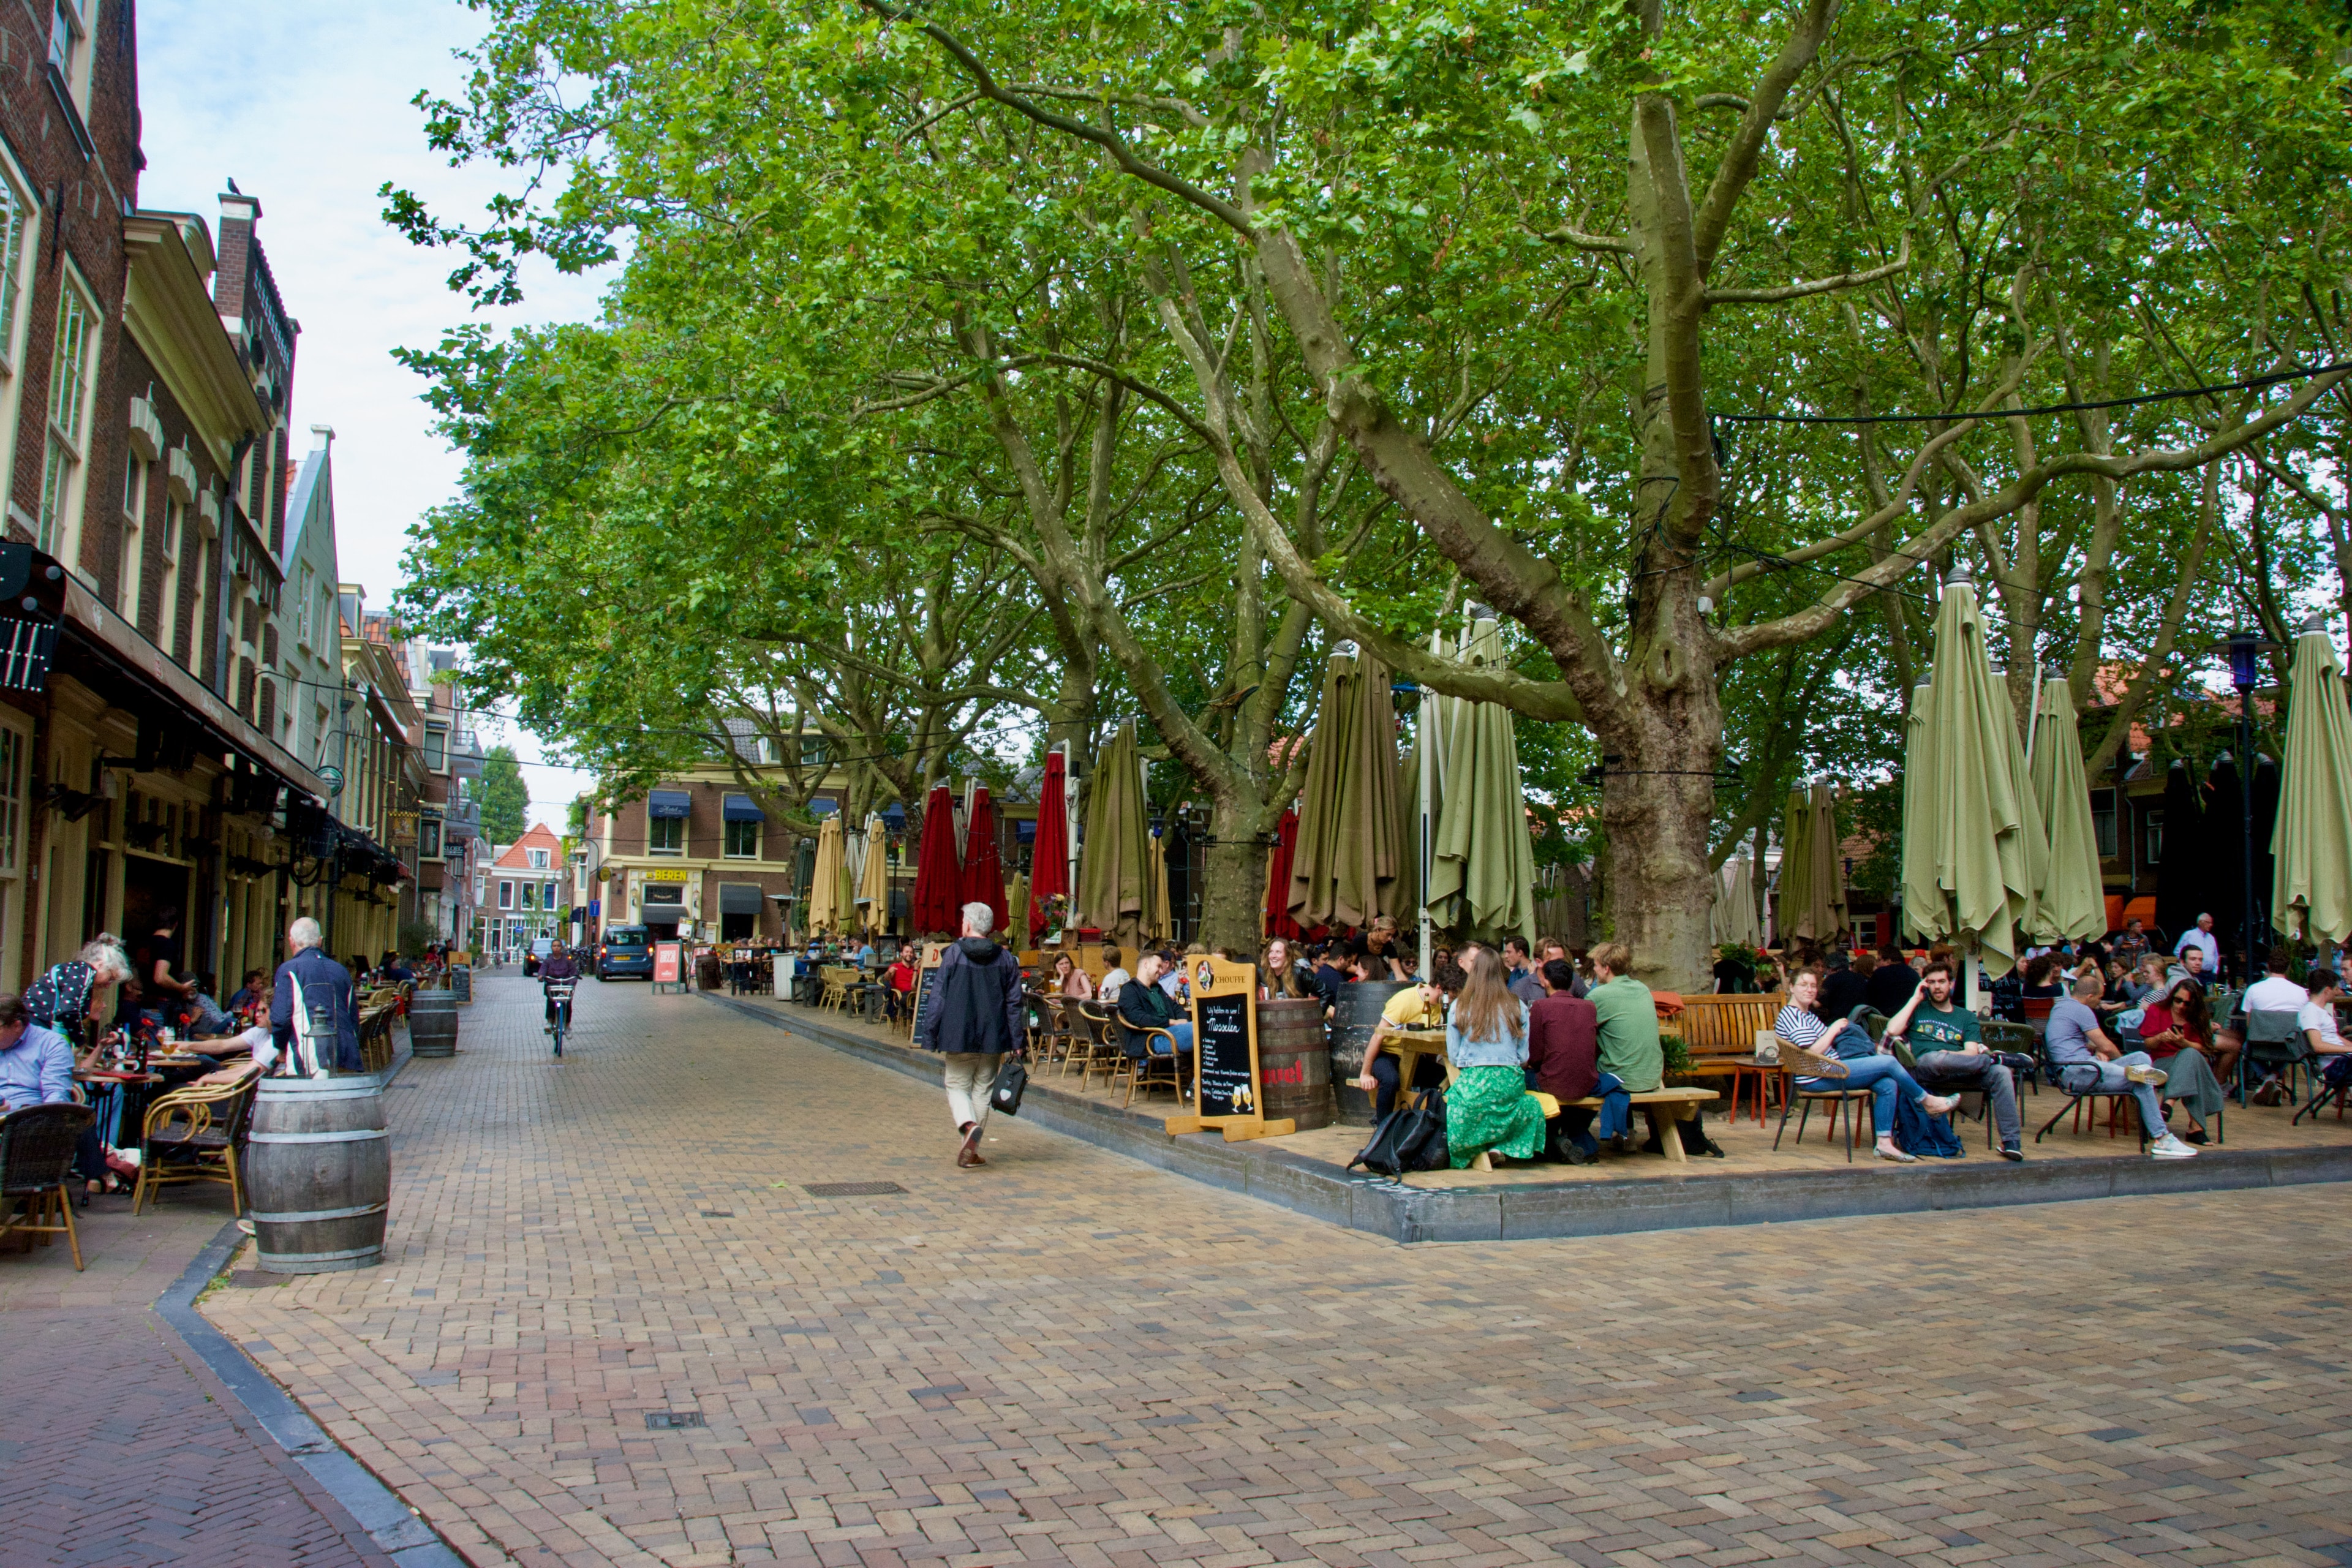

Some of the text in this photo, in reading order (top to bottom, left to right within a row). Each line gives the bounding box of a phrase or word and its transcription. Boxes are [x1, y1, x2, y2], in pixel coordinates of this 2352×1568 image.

[655, 869, 687, 881] BEREN
[1206, 1016, 1241, 1033] Mosselen
[1259, 1059, 1303, 1085] uvel
